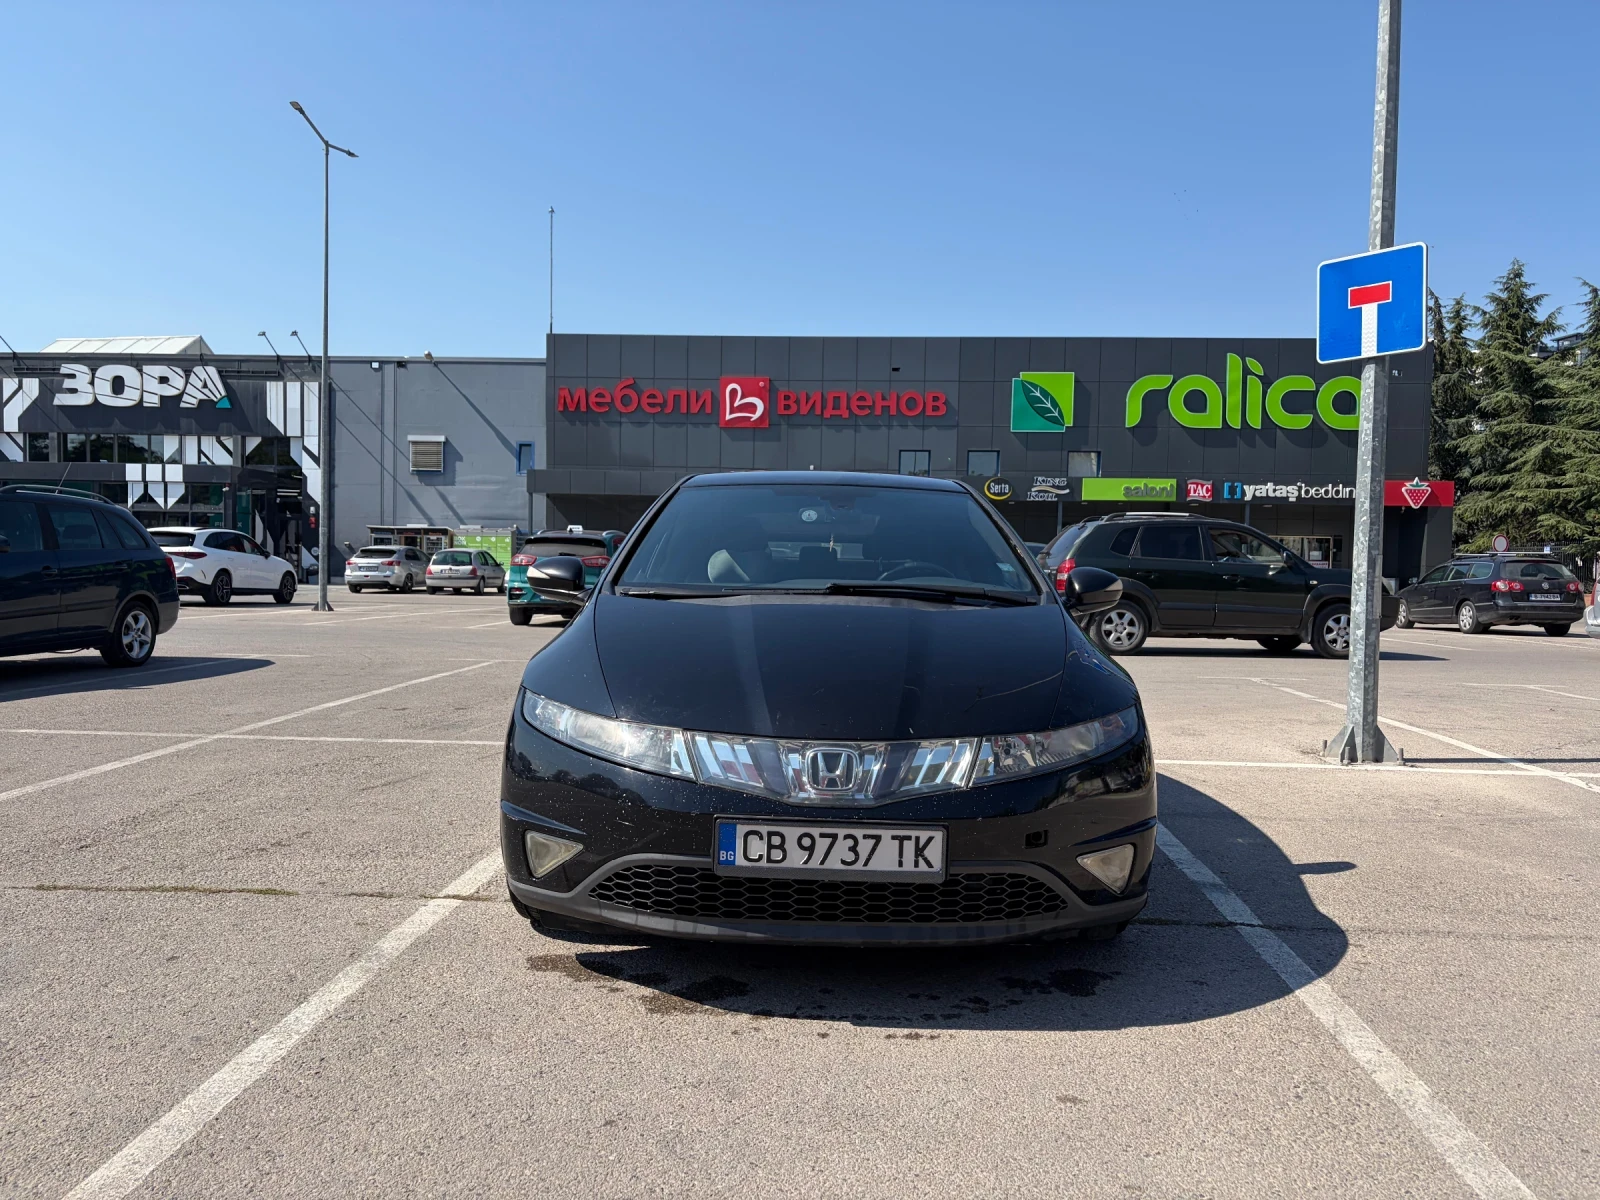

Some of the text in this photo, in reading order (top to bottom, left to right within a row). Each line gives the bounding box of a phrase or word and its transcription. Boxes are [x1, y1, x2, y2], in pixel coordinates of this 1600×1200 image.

[53, 364, 232, 408] ЗОРА
[1125, 353, 1361, 430] ralica
[557, 377, 947, 419] мебели виденов
[990, 482, 1009, 493] Serta
[1033, 476, 1067, 486] KING
[1187, 484, 1211, 498] TAÇ
[1243, 482, 1356, 501] yataş beddin
[719, 851, 734, 861] BG
[742, 830, 935, 868] CB 9737 TK
